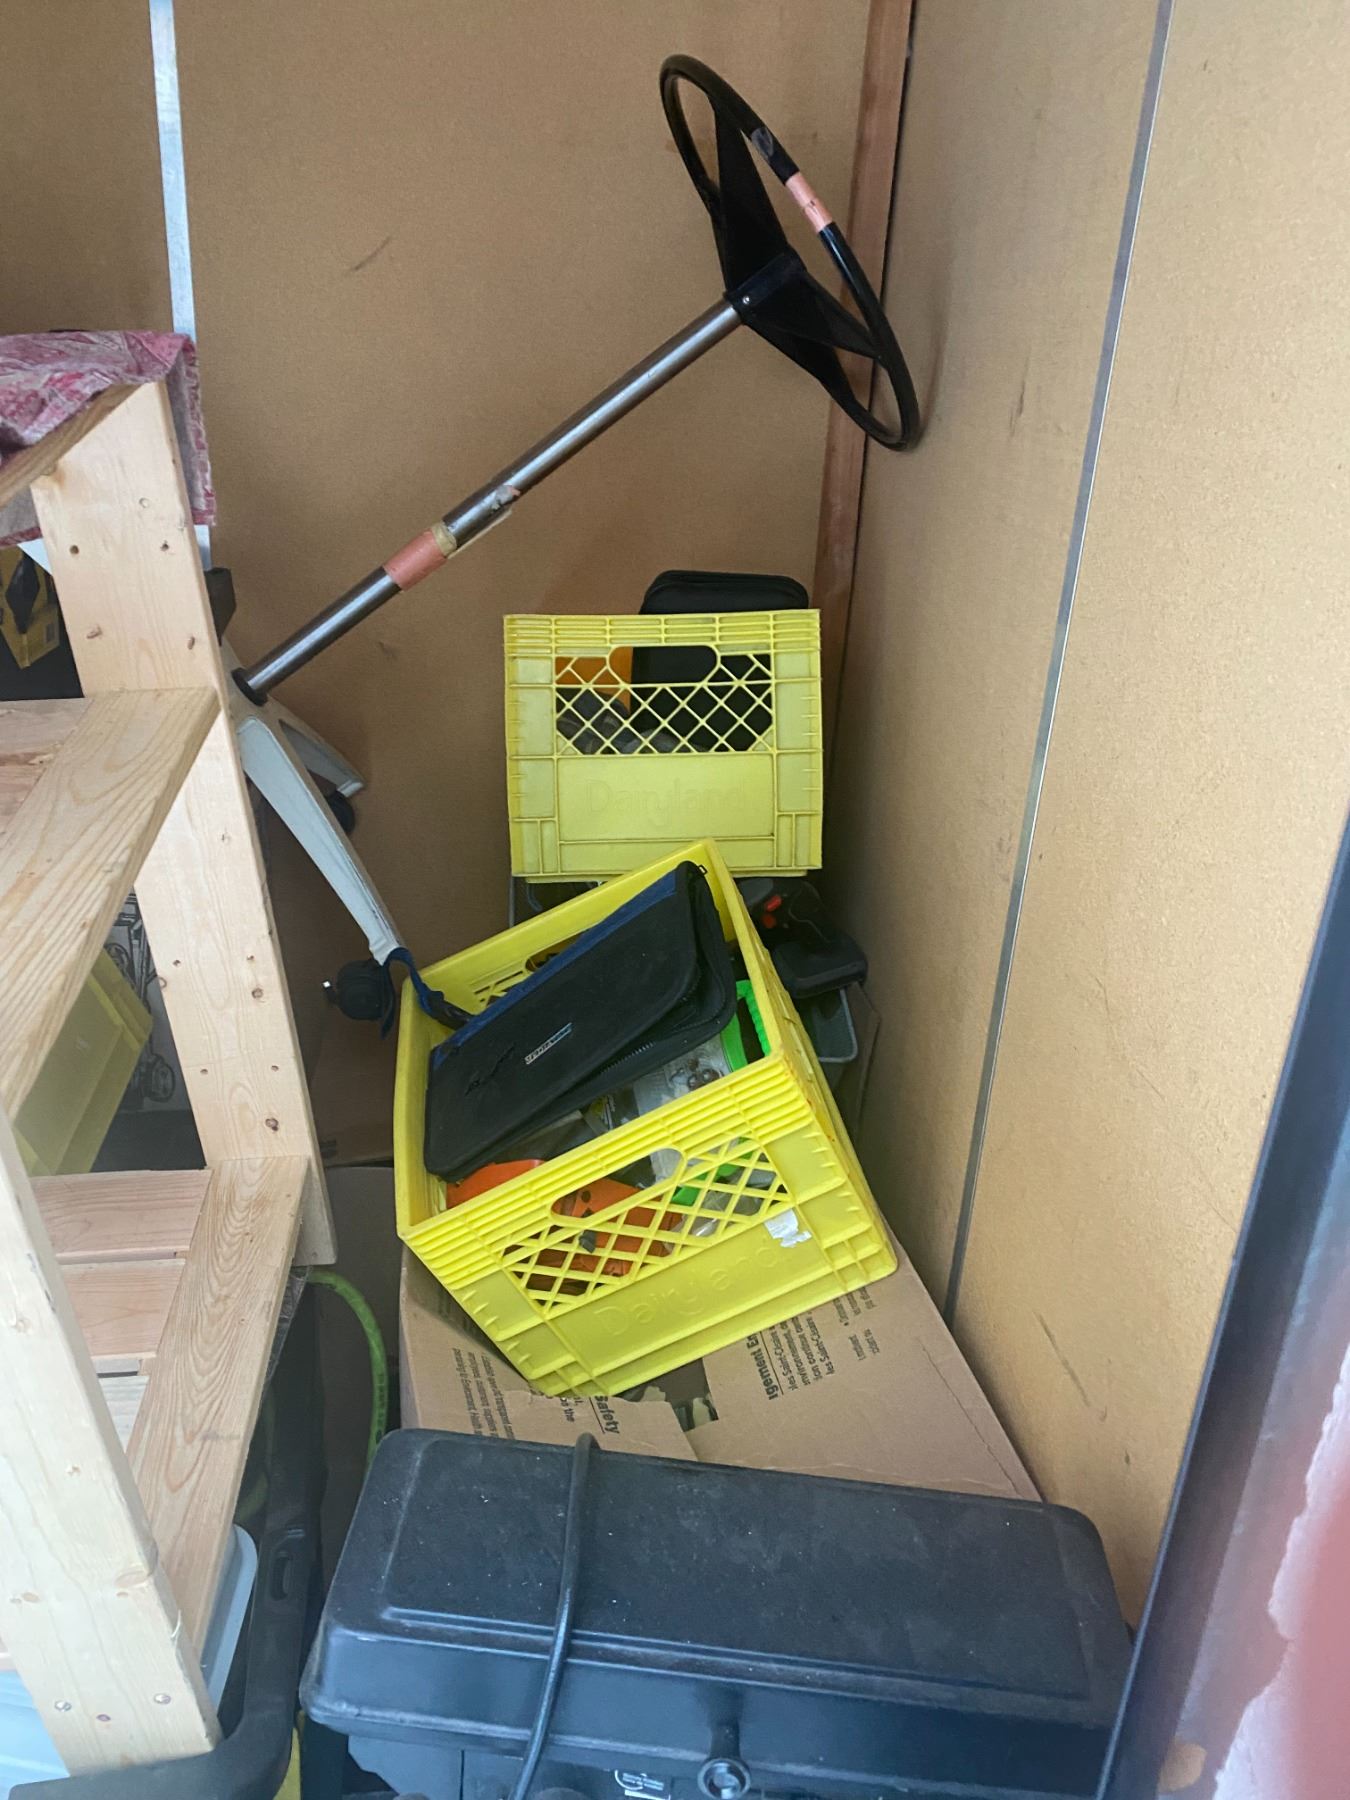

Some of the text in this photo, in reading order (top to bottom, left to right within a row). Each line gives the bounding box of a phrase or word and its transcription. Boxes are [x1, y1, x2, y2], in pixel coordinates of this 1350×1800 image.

[585, 777, 748, 828] Dairyland
[593, 1240, 779, 1336] Dairyand
[594, 1396, 621, 1434] Safety
